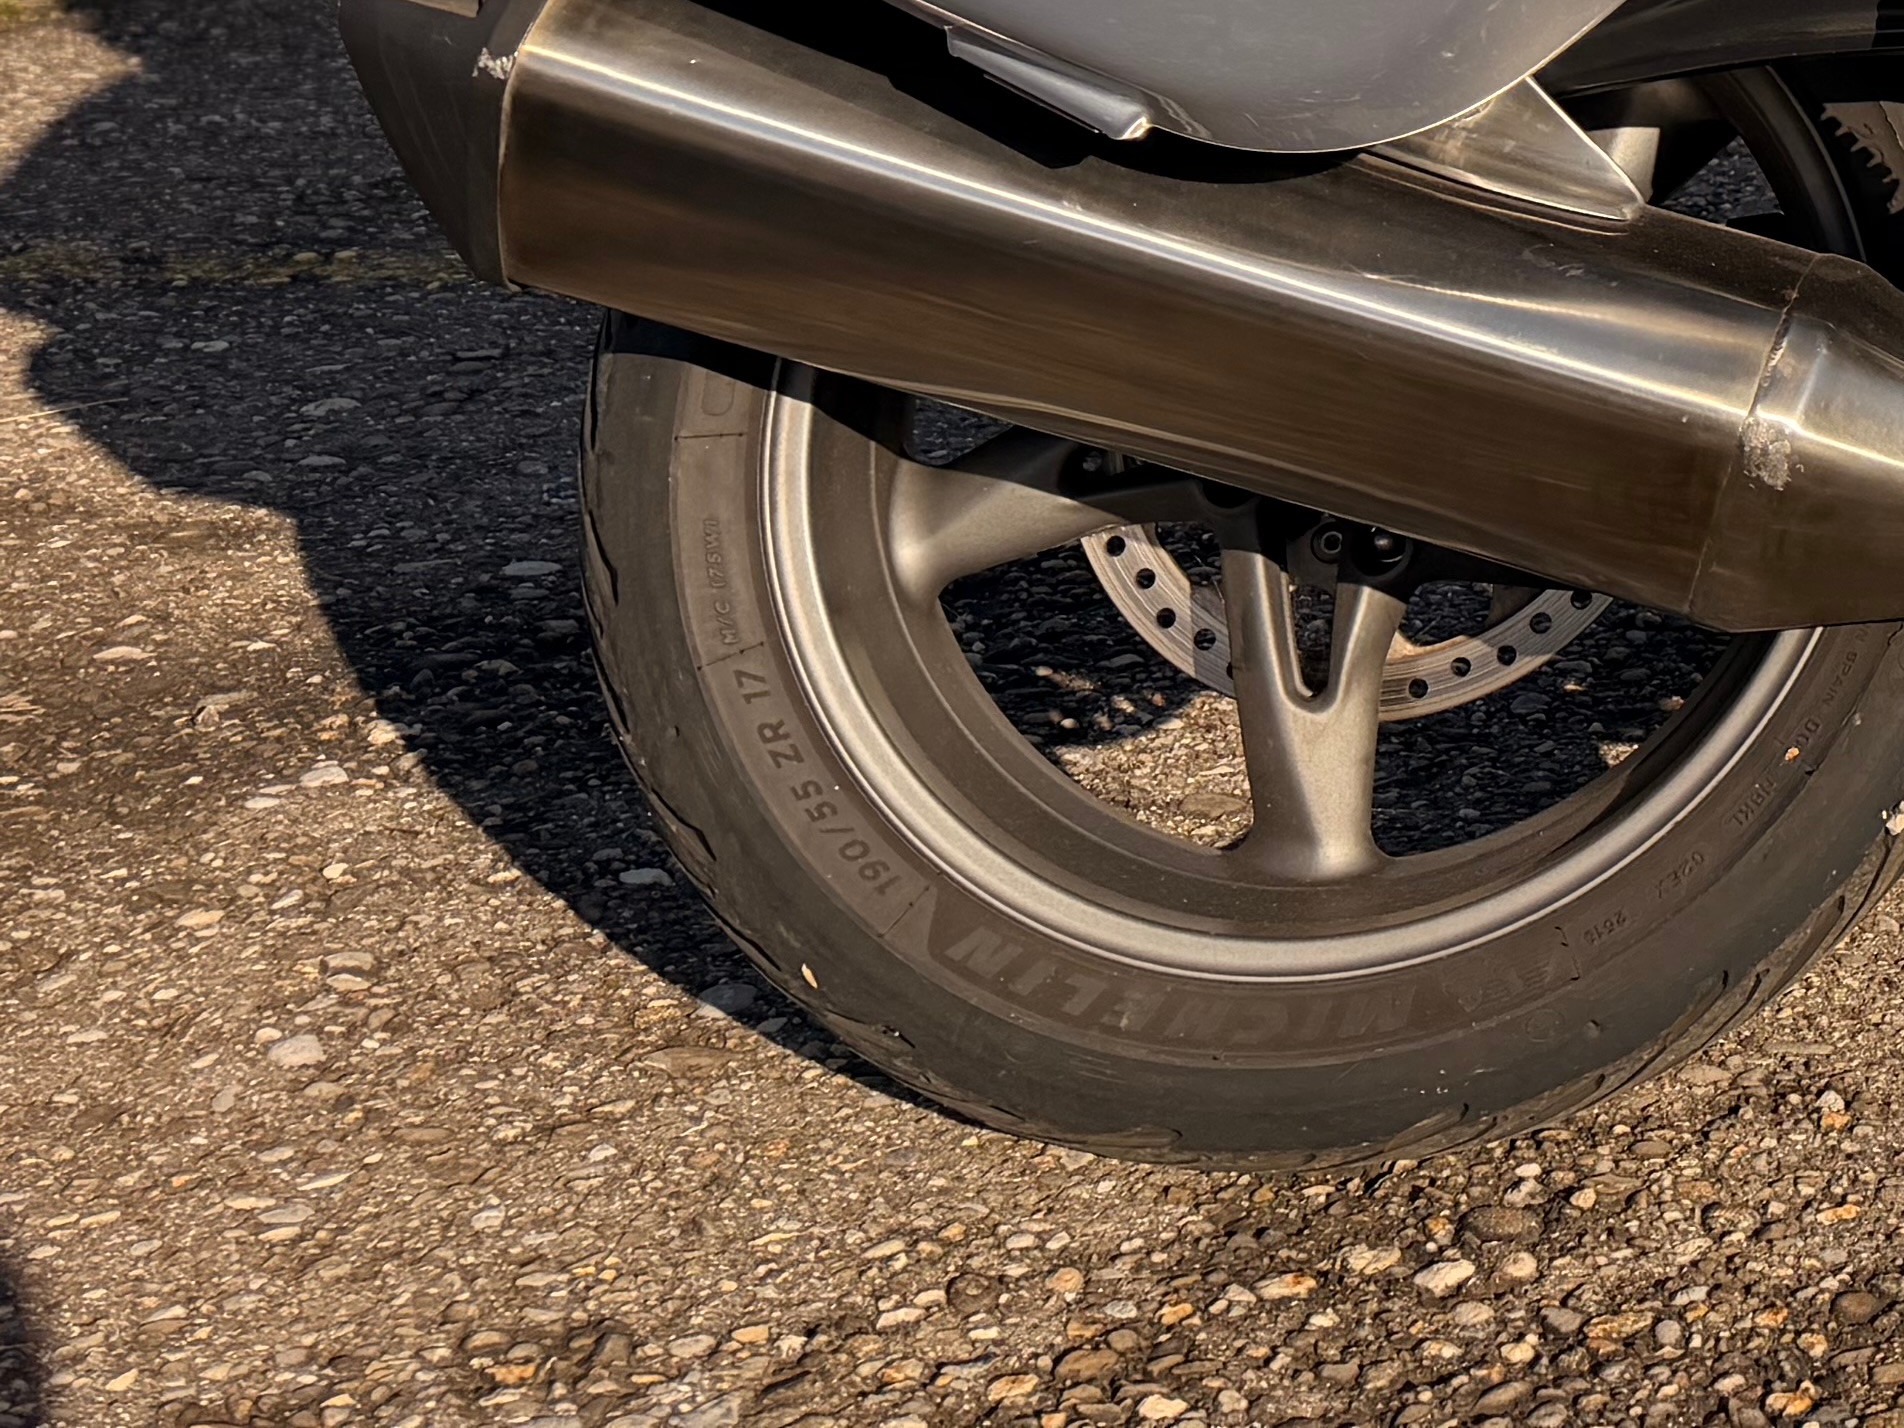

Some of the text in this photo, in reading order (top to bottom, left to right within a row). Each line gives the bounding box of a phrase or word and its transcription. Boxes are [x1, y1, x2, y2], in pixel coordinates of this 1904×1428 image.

[714, 601, 739, 645] M/C
[734, 666, 772, 705] 17
[1822, 651, 1858, 707] SPAIN
[756, 717, 805, 769] ZR
[790, 779, 904, 898] 190/55
[945, 925, 1417, 1037] MICHELIN
